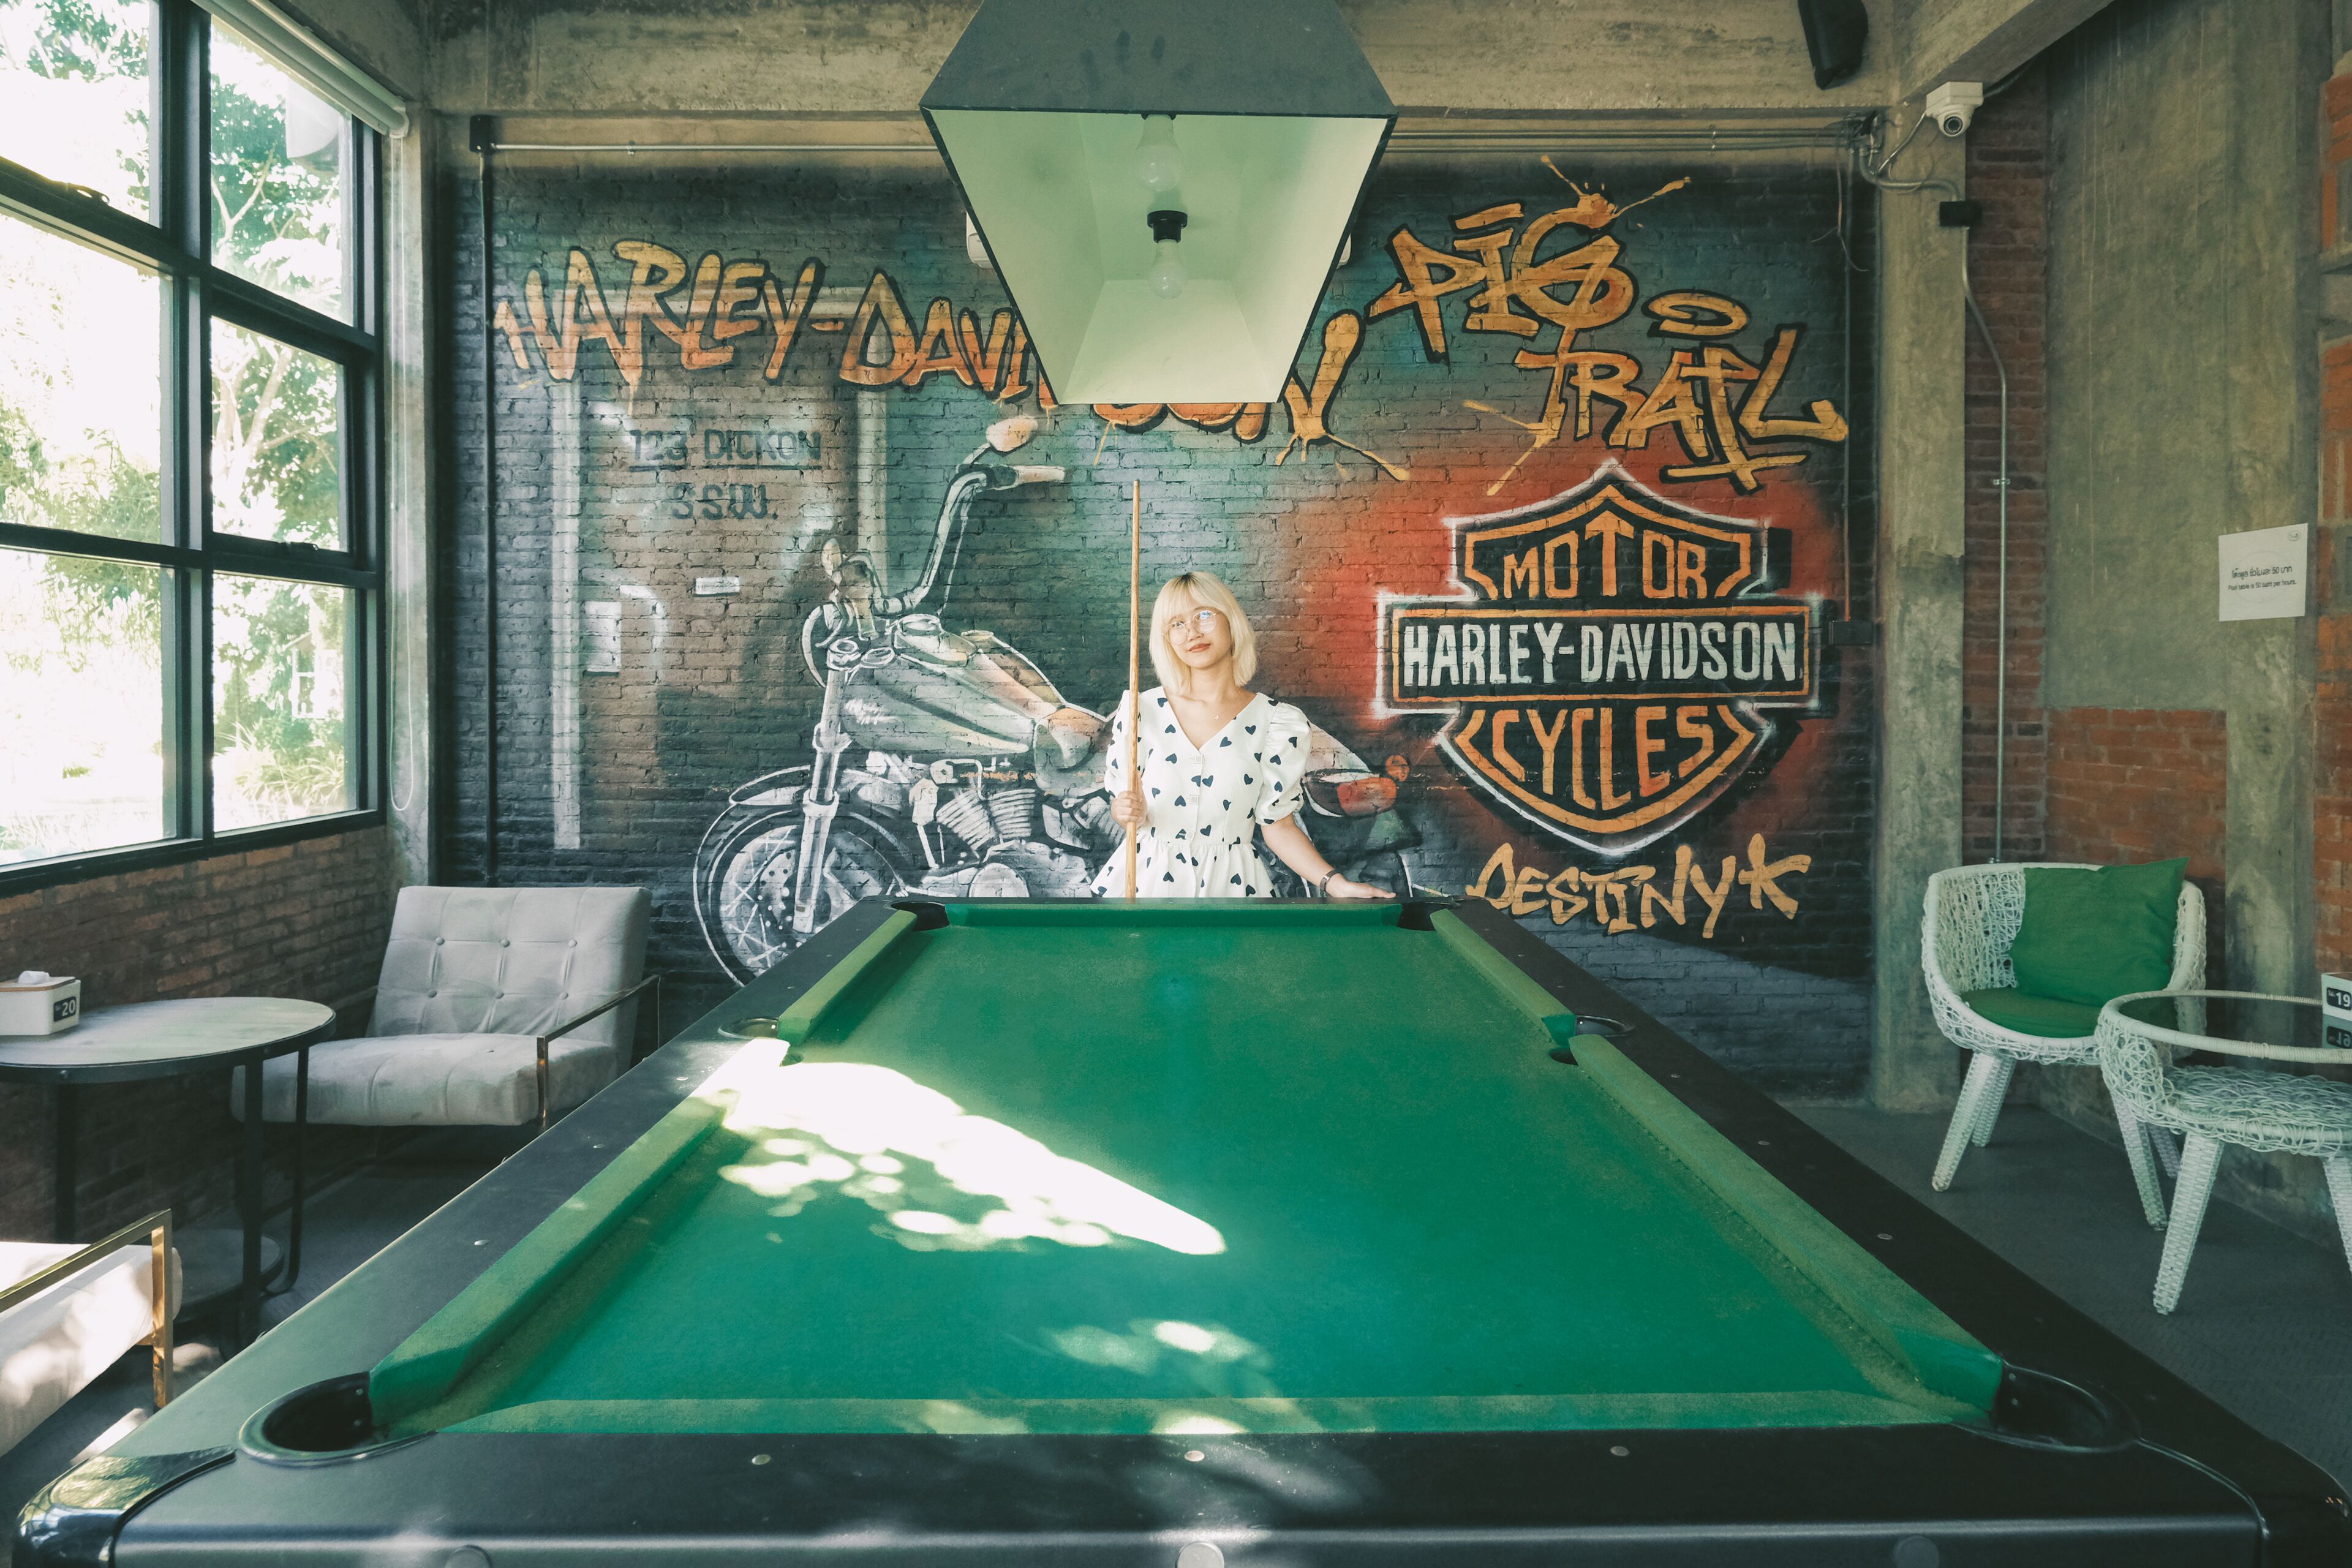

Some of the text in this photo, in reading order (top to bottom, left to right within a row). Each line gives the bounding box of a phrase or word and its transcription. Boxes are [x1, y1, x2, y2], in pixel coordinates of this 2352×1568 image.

[629, 429, 688, 460] 123
[1503, 510, 1708, 599] MOTOR
[2272, 566, 2280, 575] 50
[1403, 620, 1796, 687] HARLEY-DAVIDSON
[1493, 704, 1714, 810] CYCLES
[61, 999, 75, 1017] 20
[2335, 992, 2351, 1008] 19
